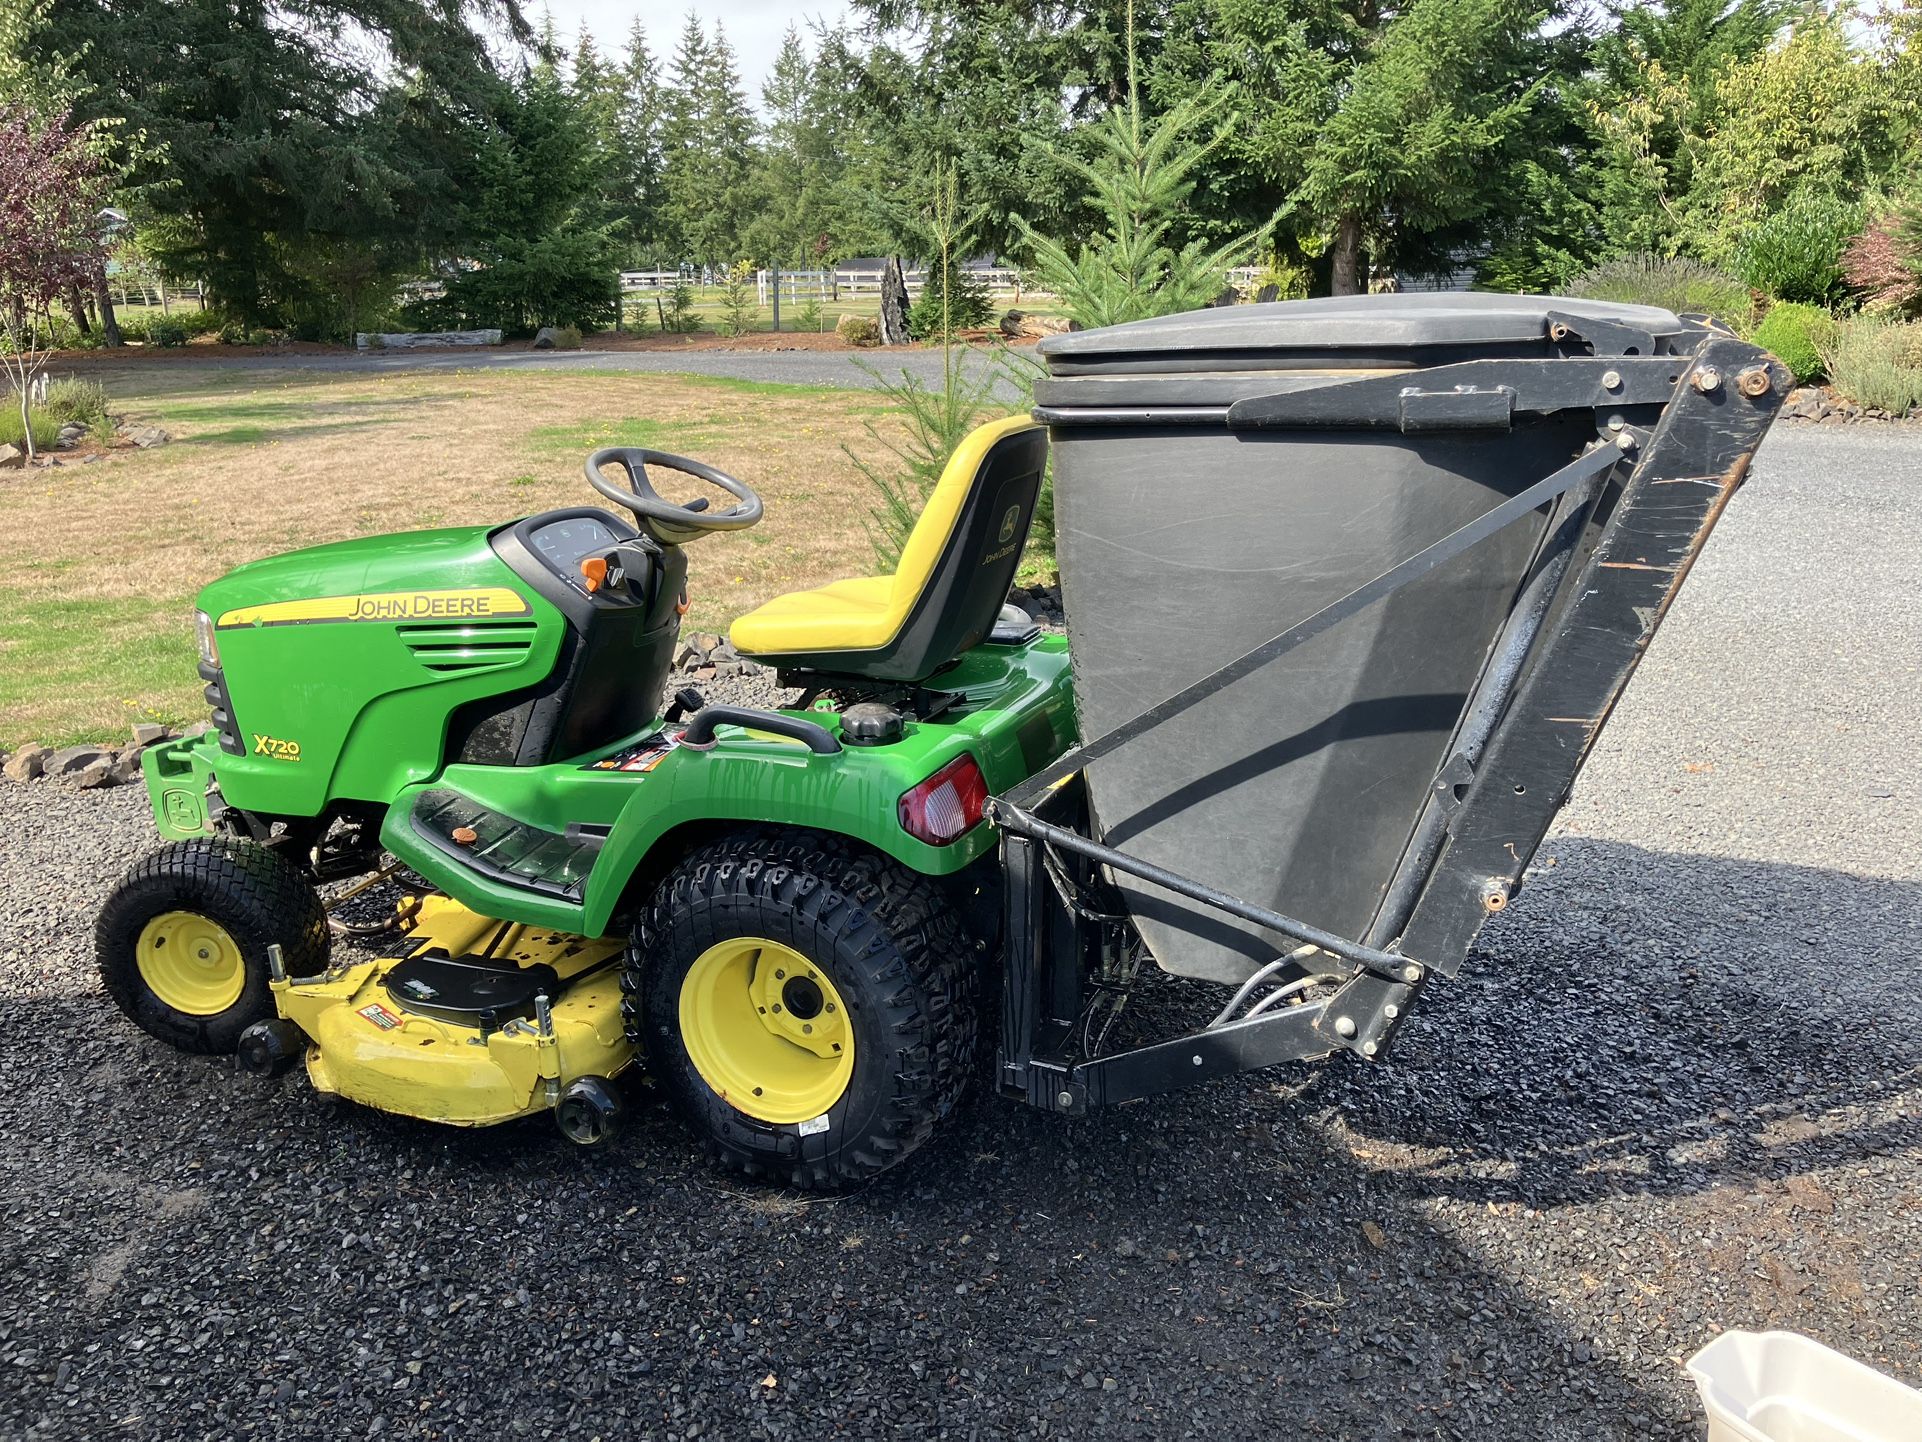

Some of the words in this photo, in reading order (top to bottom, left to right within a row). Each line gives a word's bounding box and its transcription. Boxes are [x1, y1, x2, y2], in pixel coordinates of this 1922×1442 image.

[349, 598, 407, 617] JOHN
[413, 595, 490, 615] DEERE
[253, 734, 300, 755] X720
